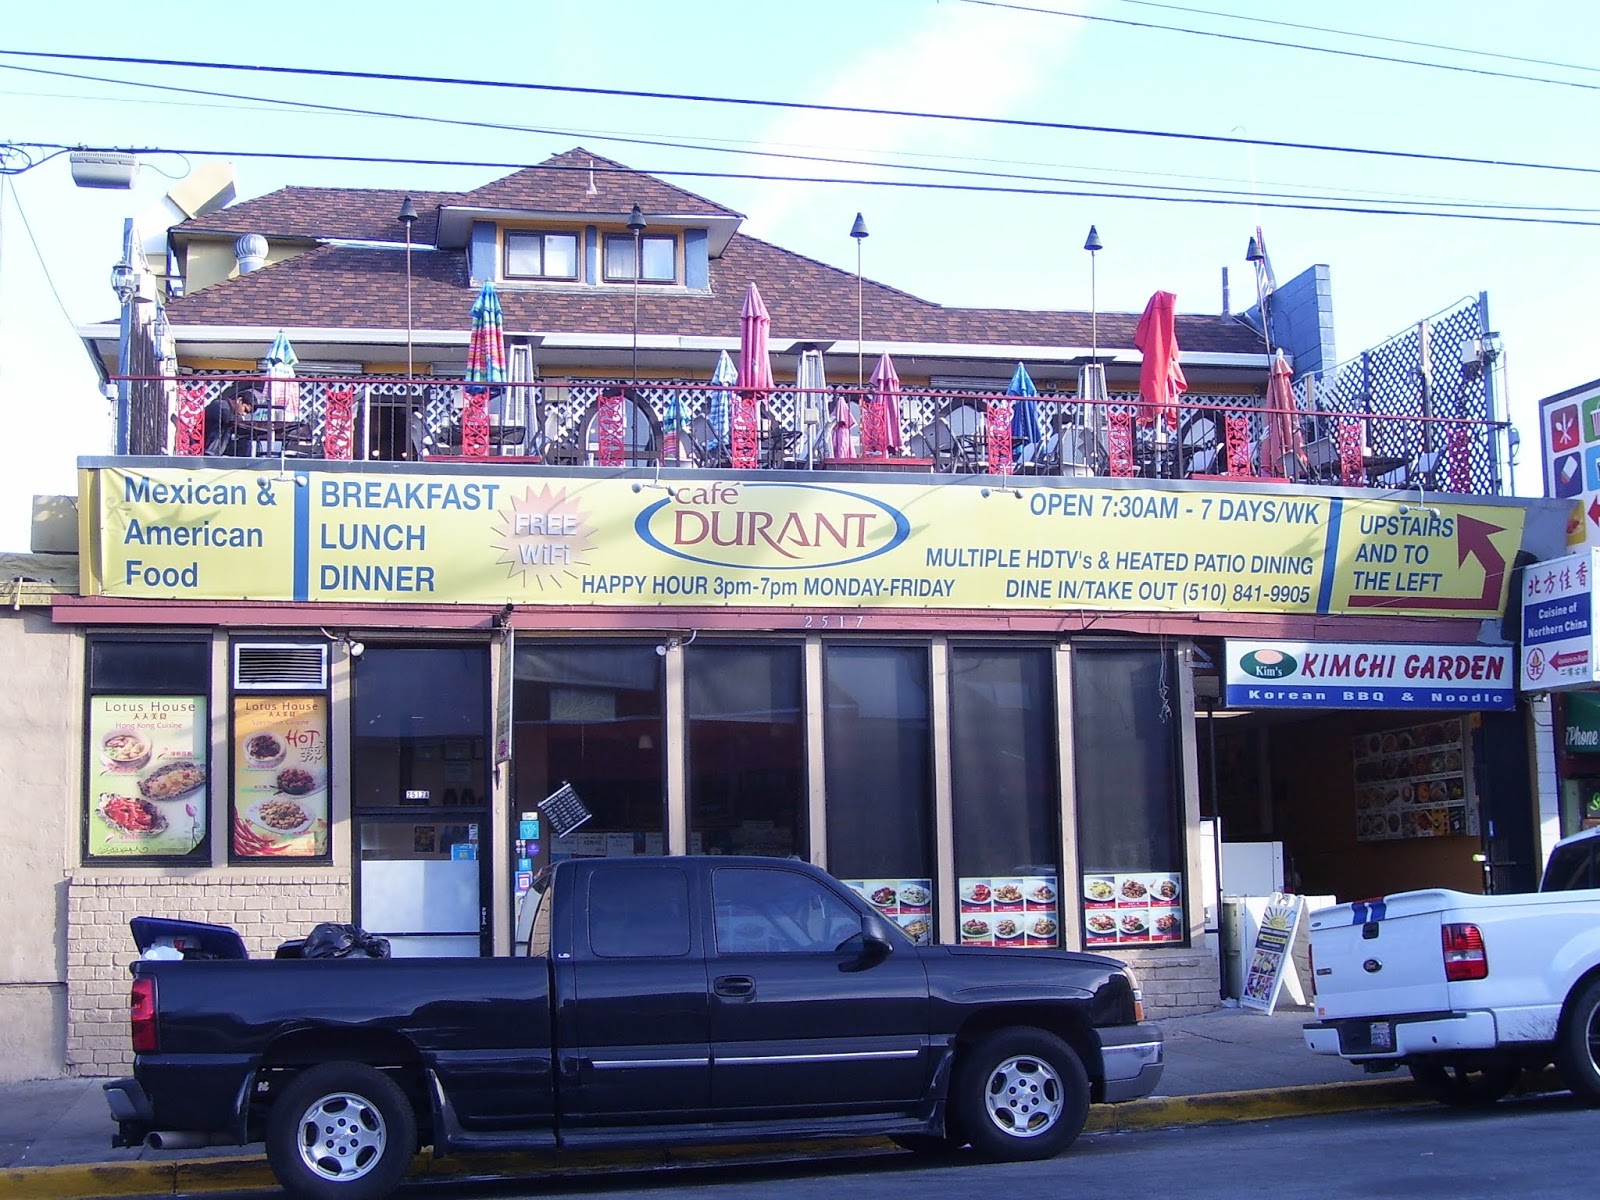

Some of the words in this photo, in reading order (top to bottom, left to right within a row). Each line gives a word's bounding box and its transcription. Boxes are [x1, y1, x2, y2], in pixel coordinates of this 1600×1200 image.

[124, 475, 246, 505] Mexican
[257, 481, 277, 506] &
[321, 481, 499, 510] BREAKFAST
[674, 482, 742, 505] café
[1030, 493, 1096, 517] OPEN
[1101, 496, 1180, 519] 7:30AM
[1201, 499, 1213, 520] 7
[1218, 499, 1320, 525] DAYS/WK
[124, 519, 263, 548] American
[515, 514, 578, 537] FREE
[673, 510, 877, 559] DURANT
[1360, 516, 1455, 538] UPSTAIRS
[321, 523, 425, 552] LUNCH
[518, 543, 571, 567] WiFi
[925, 548, 1020, 568] MULTIPLE
[1027, 549, 1093, 570] HDTV's
[1097, 551, 1111, 571] &
[1115, 552, 1189, 573] HEATED
[1194, 553, 1246, 574] PATIO
[1250, 555, 1314, 576] DINING
[1355, 543, 1398, 564] AND
[1403, 544, 1429, 565] TO
[126, 560, 198, 589] Food
[320, 565, 434, 592] DINNER
[1353, 571, 1391, 590] THE
[1394, 572, 1443, 593] LEFT
[582, 576, 646, 594] HAPPY
[652, 577, 708, 595] HOUR
[713, 578, 798, 600] 3pm-7pm
[803, 578, 955, 597] MONDAY-FRIDAY
[1006, 579, 1054, 599] DINE
[1057, 580, 1134, 601] IN/TAKE
[1138, 581, 1178, 602] OUT
[1182, 582, 1227, 605] (510)
[1232, 583, 1311, 604] 841-9905
[805, 615, 864, 629] 2517
[1538, 606, 1567, 619] Cuisine
[1568, 602, 1577, 613] of
[1528, 625, 1564, 639] Northern
[1564, 620, 1588, 632] China
[1255, 665, 1283, 677] Kim's
[1301, 653, 1397, 679] KIMCHI
[1404, 654, 1504, 681] GARDEN
[105, 702, 144, 712] Lotus
[151, 702, 196, 712] House
[245, 702, 277, 711] Lotus
[282, 702, 318, 711] House
[1249, 690, 1326, 701] Korean
[1343, 691, 1385, 702] BBQ
[1401, 692, 1415, 702] &
[1431, 692, 1503, 703] Noodle
[115, 722, 135, 730] Hong
[137, 722, 155, 730] Kong
[1566, 726, 1597, 746] iPhone
